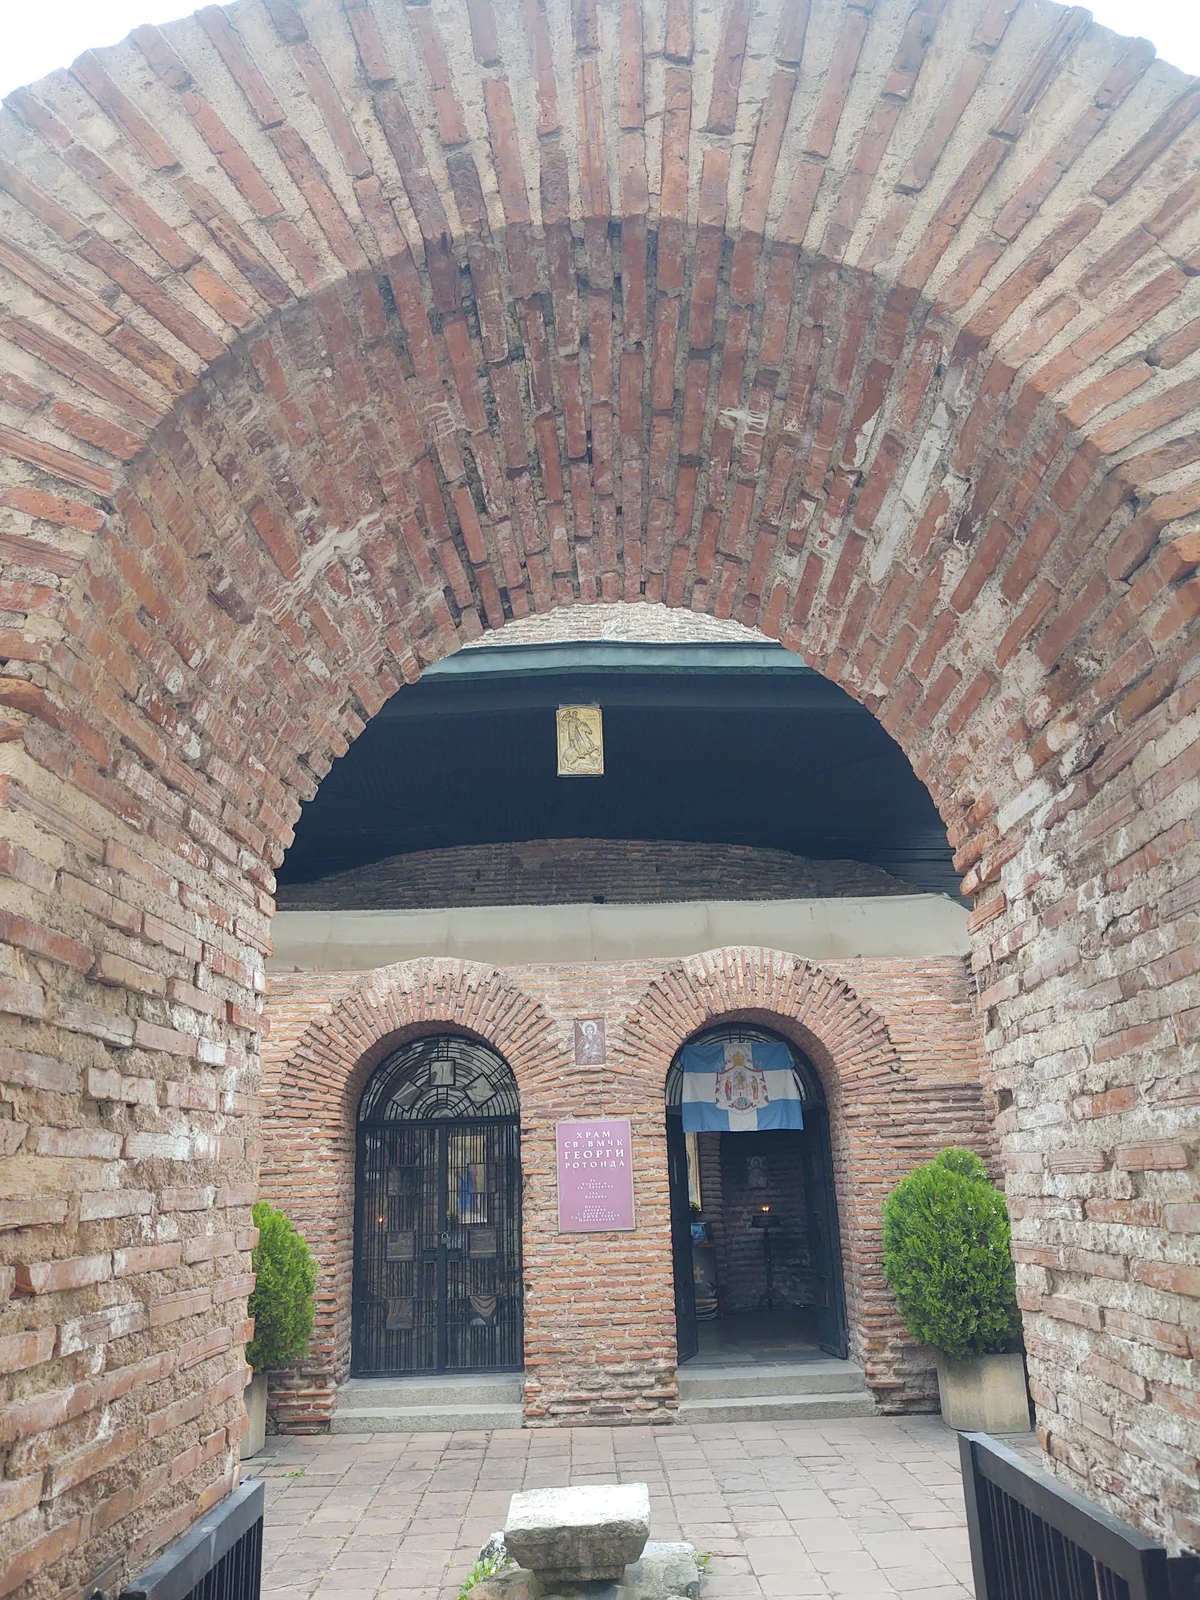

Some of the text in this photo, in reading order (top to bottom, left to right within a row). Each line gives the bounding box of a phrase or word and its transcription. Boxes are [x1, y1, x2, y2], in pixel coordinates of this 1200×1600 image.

[576, 1130, 611, 1139] ХРАМ
[564, 1149, 624, 1160] ГЕОРГИ
[565, 1160, 625, 1169] РОТОНДА
